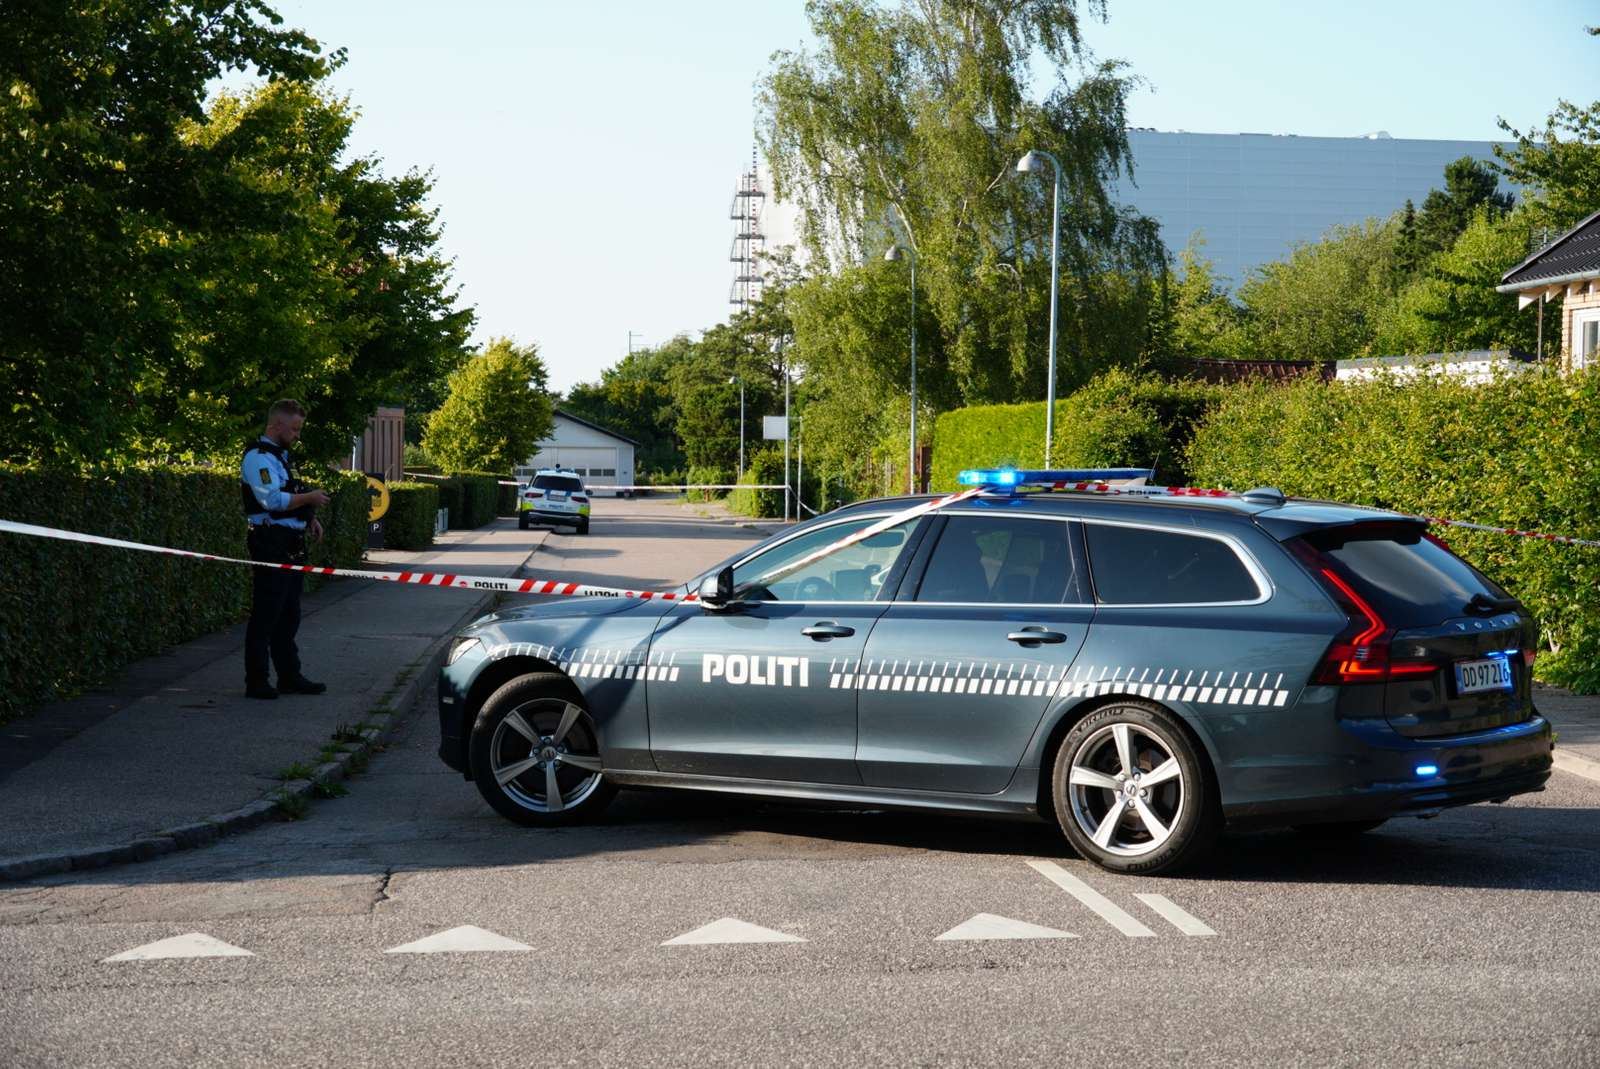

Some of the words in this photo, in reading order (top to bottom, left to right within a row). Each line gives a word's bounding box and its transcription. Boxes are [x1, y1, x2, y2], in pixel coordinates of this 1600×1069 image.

[474, 581, 508, 590] POLITI
[702, 653, 809, 687] POLITI
[1478, 664, 1490, 686] 97
[1491, 661, 1510, 684] 216
